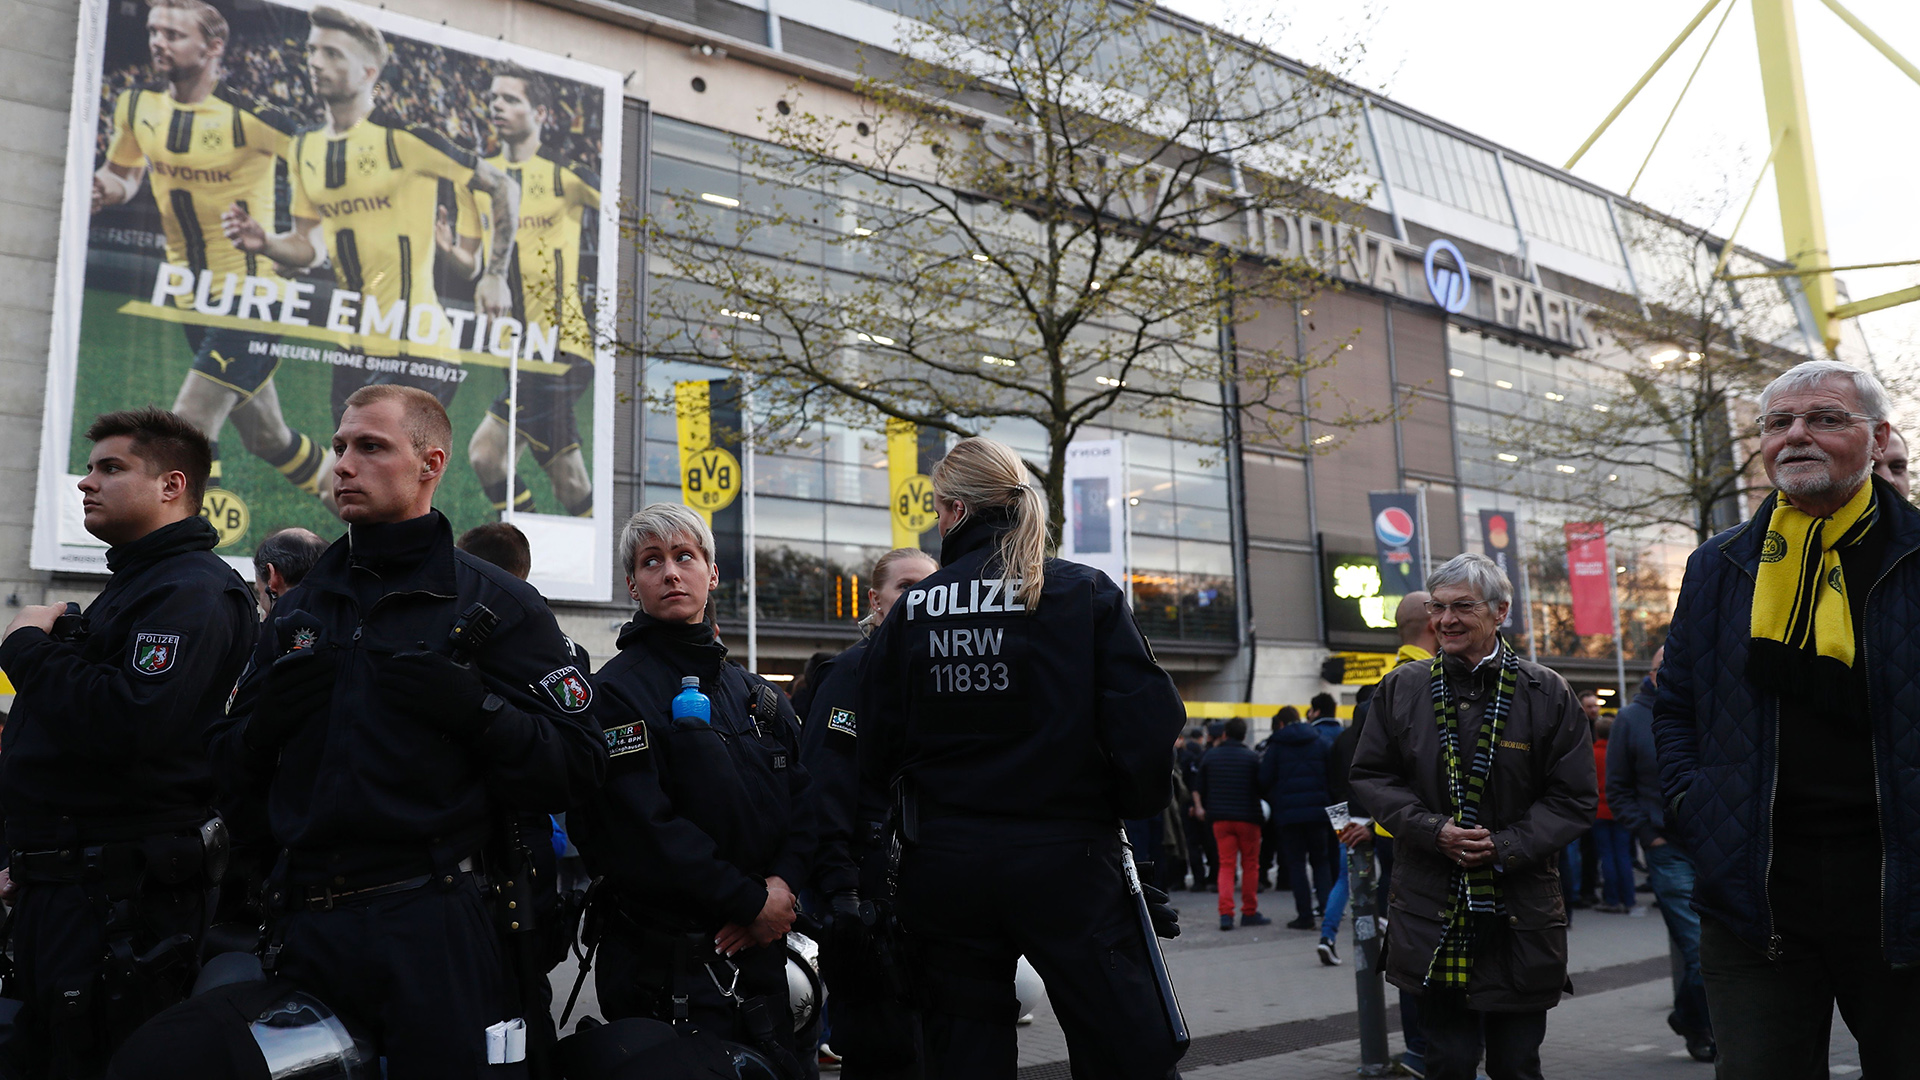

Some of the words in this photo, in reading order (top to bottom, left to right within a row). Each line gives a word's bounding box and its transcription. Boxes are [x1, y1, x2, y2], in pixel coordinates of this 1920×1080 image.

[1245, 198, 1401, 294] IDUNA
[1491, 274, 1589, 350] PARK
[152, 262, 315, 327] PURE
[326, 288, 560, 364] EMOTION
[248, 341, 268, 355] IM
[269, 343, 320, 363] NEUEN
[321, 349, 364, 370] HOME
[365, 356, 409, 375] SHIRT
[409, 362, 468, 383] 2016/17
[906, 578, 1036, 621] POLIZE
[138, 635, 178, 644] POLIZEI
[929, 627, 1004, 658] NRW
[930, 661, 1010, 693] 11833
[619, 725, 642, 736] NRW
